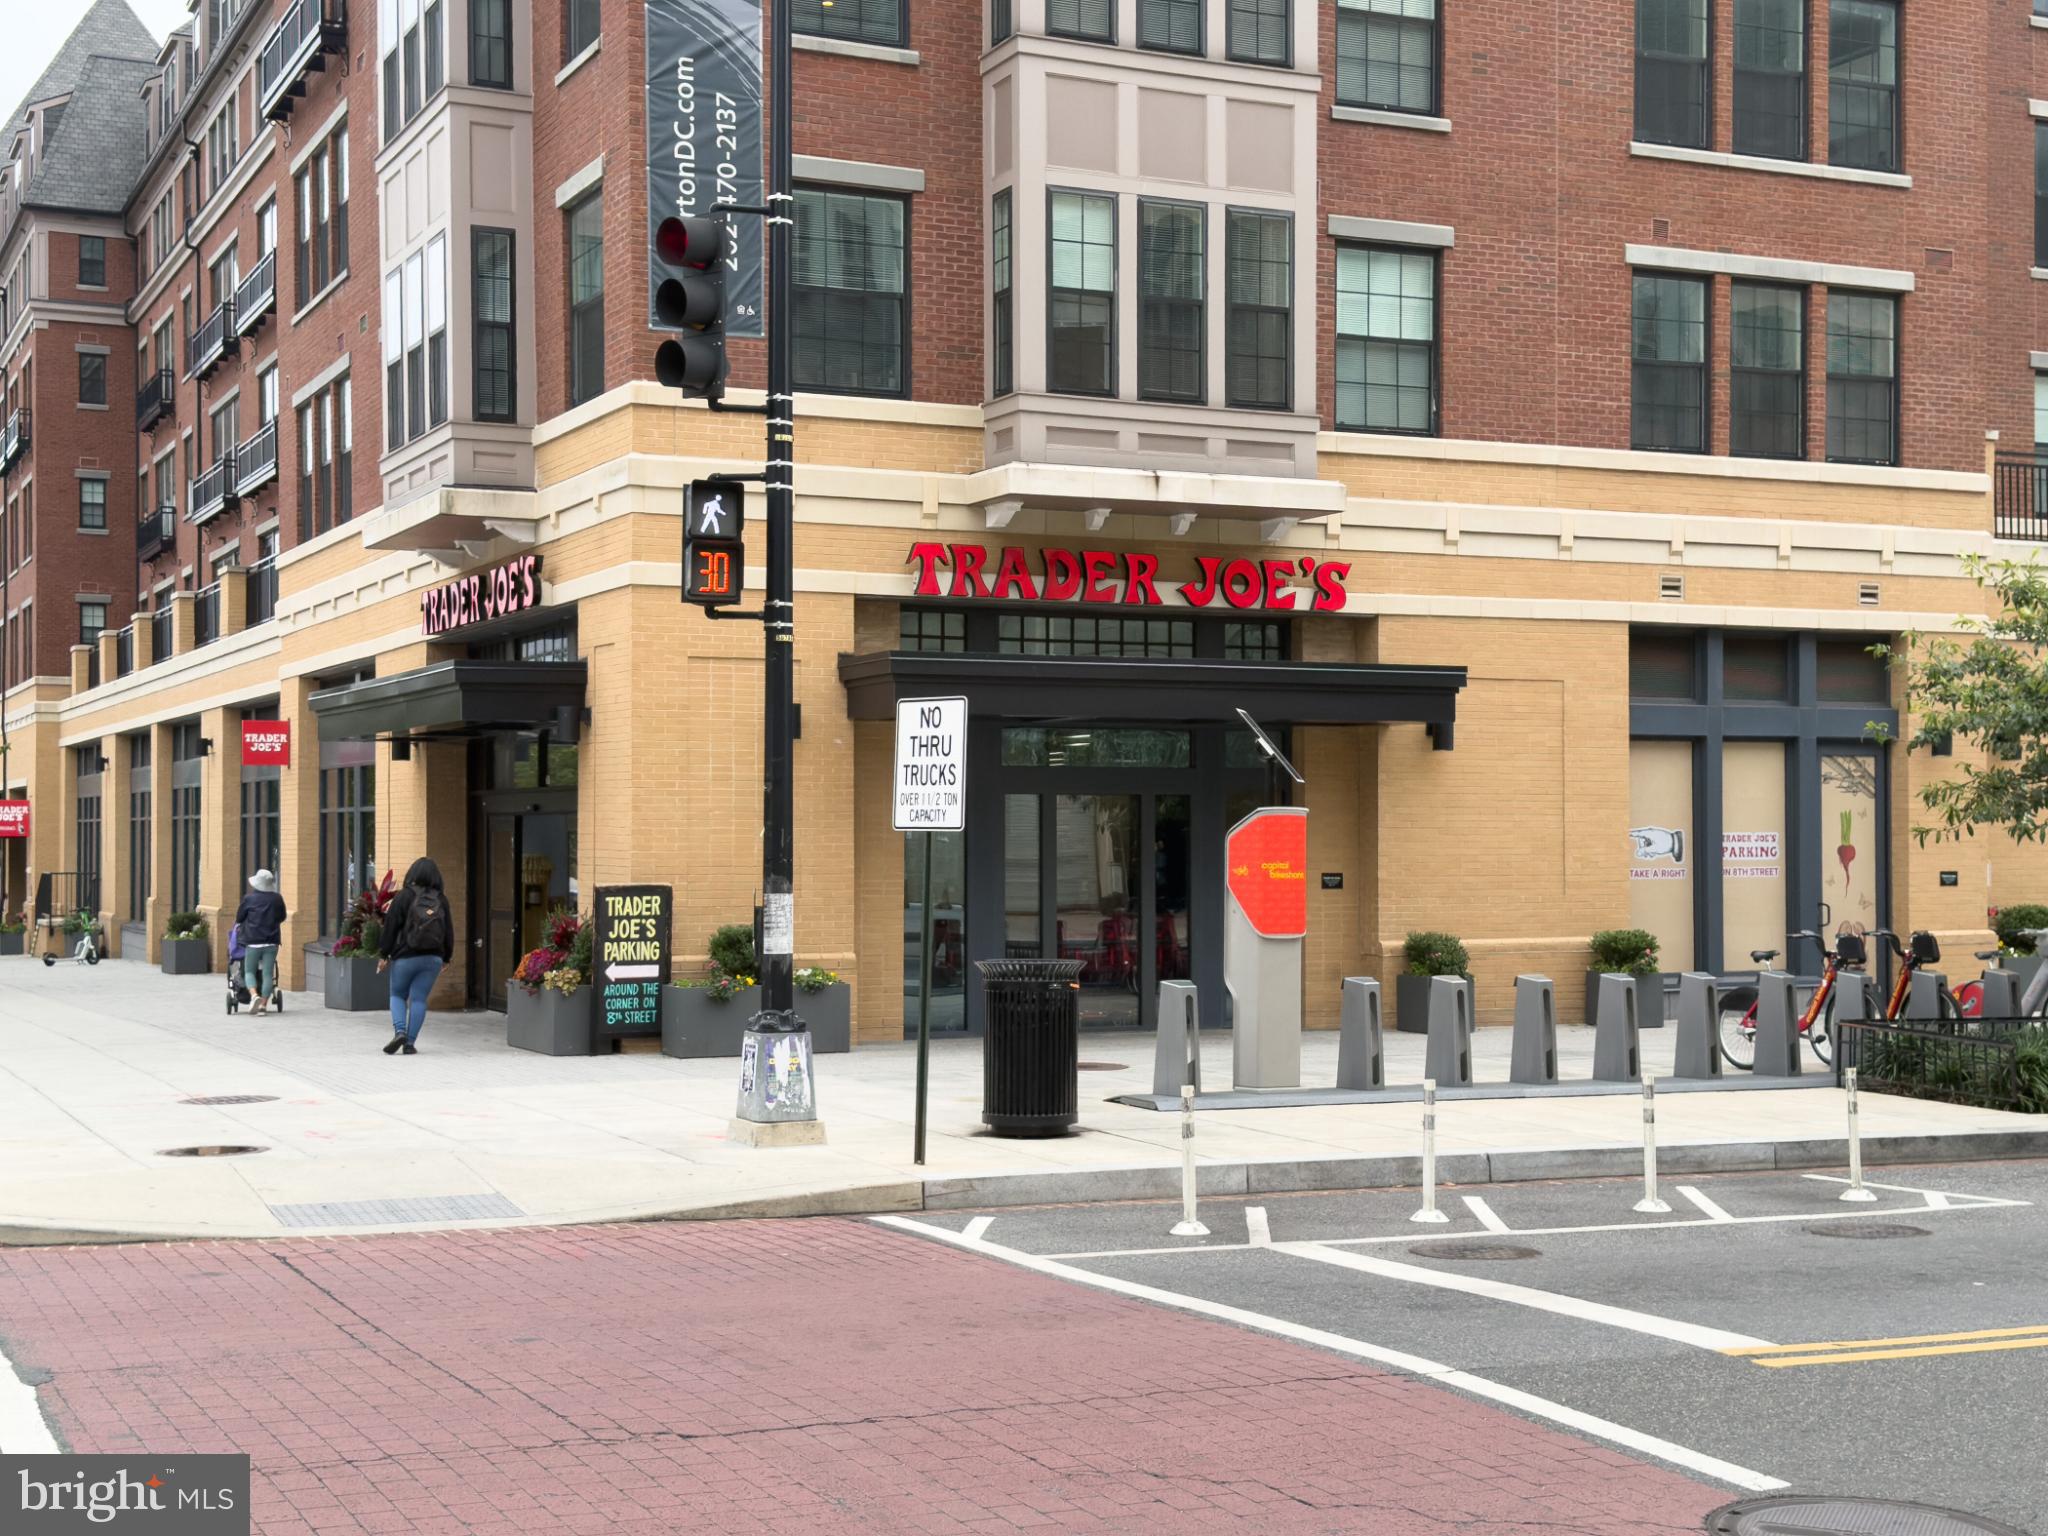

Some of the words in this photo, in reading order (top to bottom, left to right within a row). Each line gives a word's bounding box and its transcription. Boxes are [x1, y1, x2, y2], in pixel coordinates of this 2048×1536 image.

[699, 552, 730, 593] 30
[905, 541, 1163, 605] TRADER
[1177, 556, 1353, 611] JOE'S
[421, 575, 480, 636] TRADER
[484, 555, 537, 620] JOE'S
[920, 706, 942, 728] NO
[245, 733, 288, 743] TRADER
[250, 743, 282, 752] JOE'S
[910, 735, 952, 757] THRU
[903, 763, 957, 786] TRUCKS
[900, 792, 919, 806] OVER
[944, 792, 958, 806] TON
[909, 808, 947, 822] CAPACITY
[1720, 846, 1778, 857] PARKING
[1630, 869, 1650, 878] TAKE
[1652, 869, 1659, 878] A
[1661, 869, 1686, 878] RIGHT
[1733, 867, 1748, 876] 8TH
[1750, 867, 1778, 876] STREET
[605, 896, 661, 917] TRADER
[609, 919, 657, 939] JOE'S
[604, 941, 660, 962] PARKING
[604, 984, 639, 996] AROUND
[642, 982, 659, 995] THE
[605, 998, 640, 1010] CORNER
[643, 997, 656, 1009] ON
[624, 1010, 657, 1024] STREET
